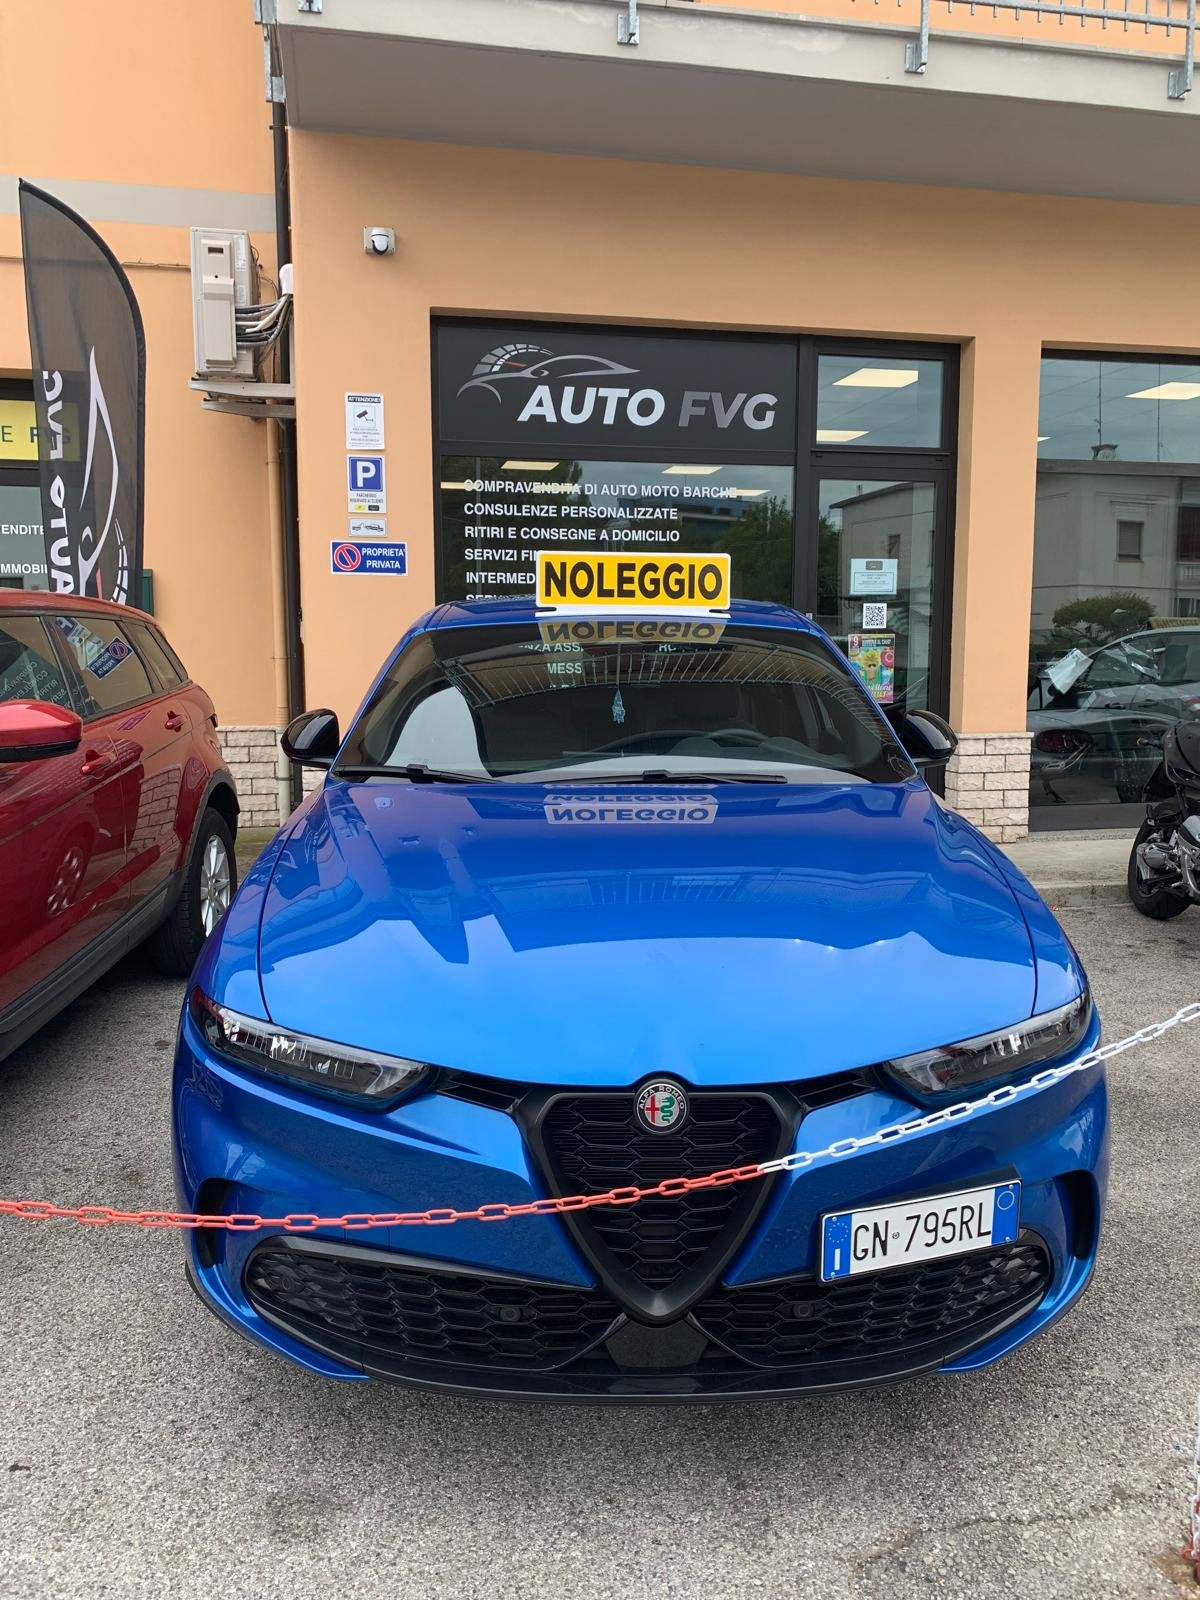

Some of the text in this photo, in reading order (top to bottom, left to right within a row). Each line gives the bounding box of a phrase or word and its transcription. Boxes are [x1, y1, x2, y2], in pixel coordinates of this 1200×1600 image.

[517, 385, 778, 430] AUTO FVG
[357, 461, 376, 488] P
[464, 479, 738, 499] COMPRAVENDITA DI AUTO MOTO BARCHE
[464, 503, 678, 519] CONSULENZE PERSONALIZZATE
[465, 526, 680, 542] RITIRI E CONSEGNE A DOMICILIO
[366, 560, 401, 569] PRIVATA
[464, 548, 517, 561] SERVIZI
[544, 561, 723, 600] NOLEGGIO
[639, 1085, 684, 1110] ALFA ROMEO
[853, 1202, 991, 1261] GN 795RL
